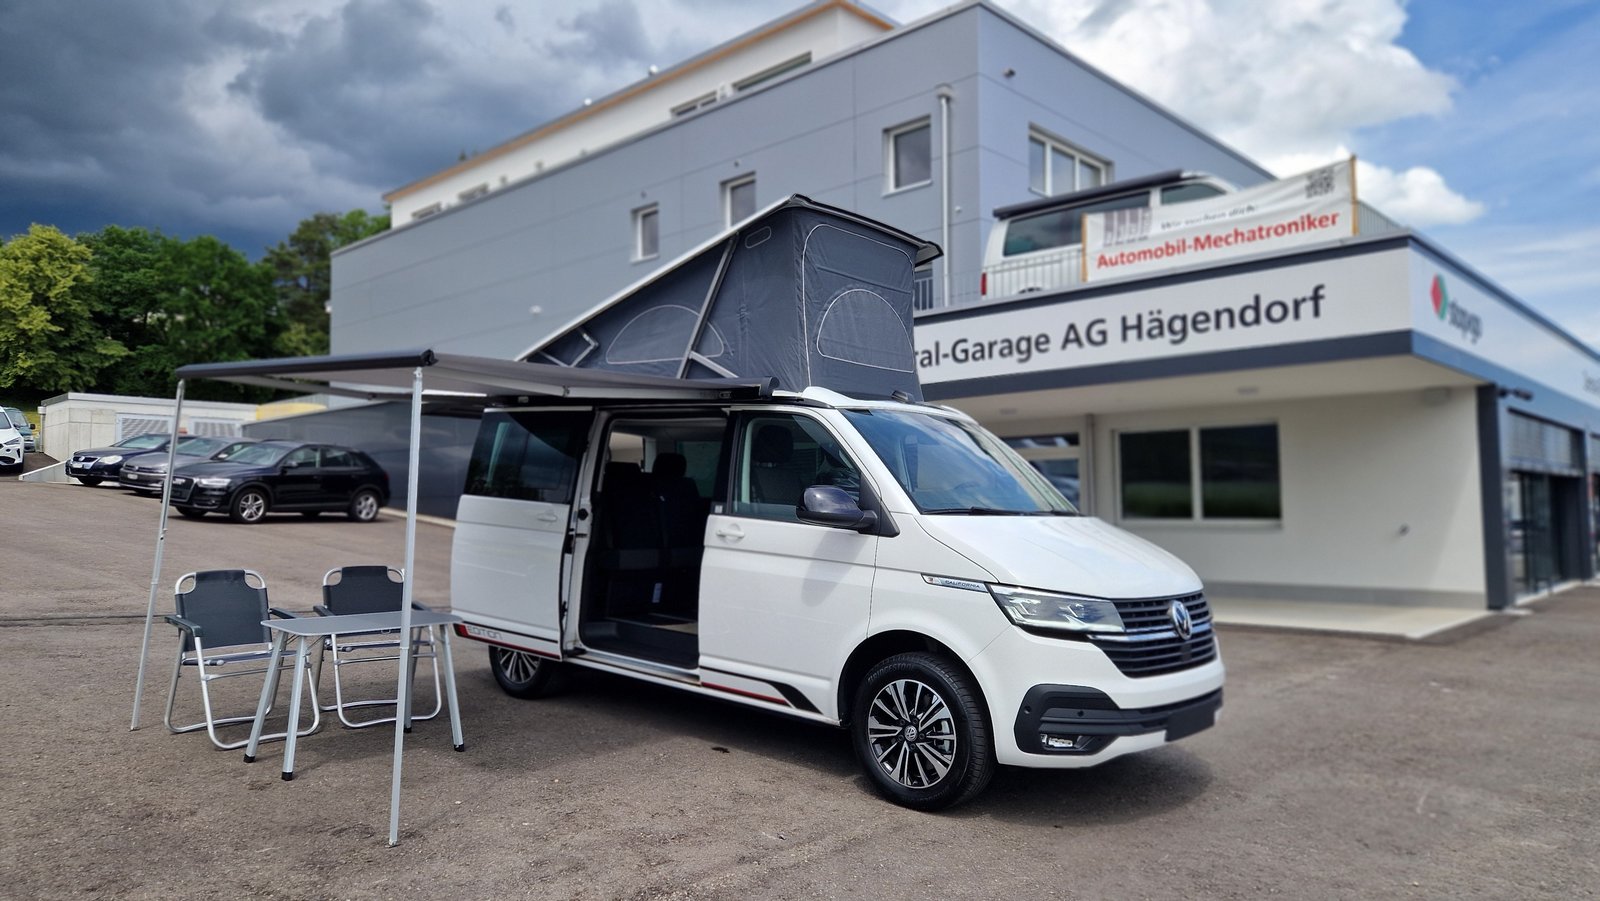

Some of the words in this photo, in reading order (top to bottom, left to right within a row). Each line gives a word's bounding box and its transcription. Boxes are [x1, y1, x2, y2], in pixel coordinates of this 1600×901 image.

[1097, 211, 1340, 269] Automobil-Mechatroniker
[1061, 318, 1108, 350] AG
[1121, 284, 1326, 346] Hägendorf
[944, 580, 980, 589] CALIFORNIA
